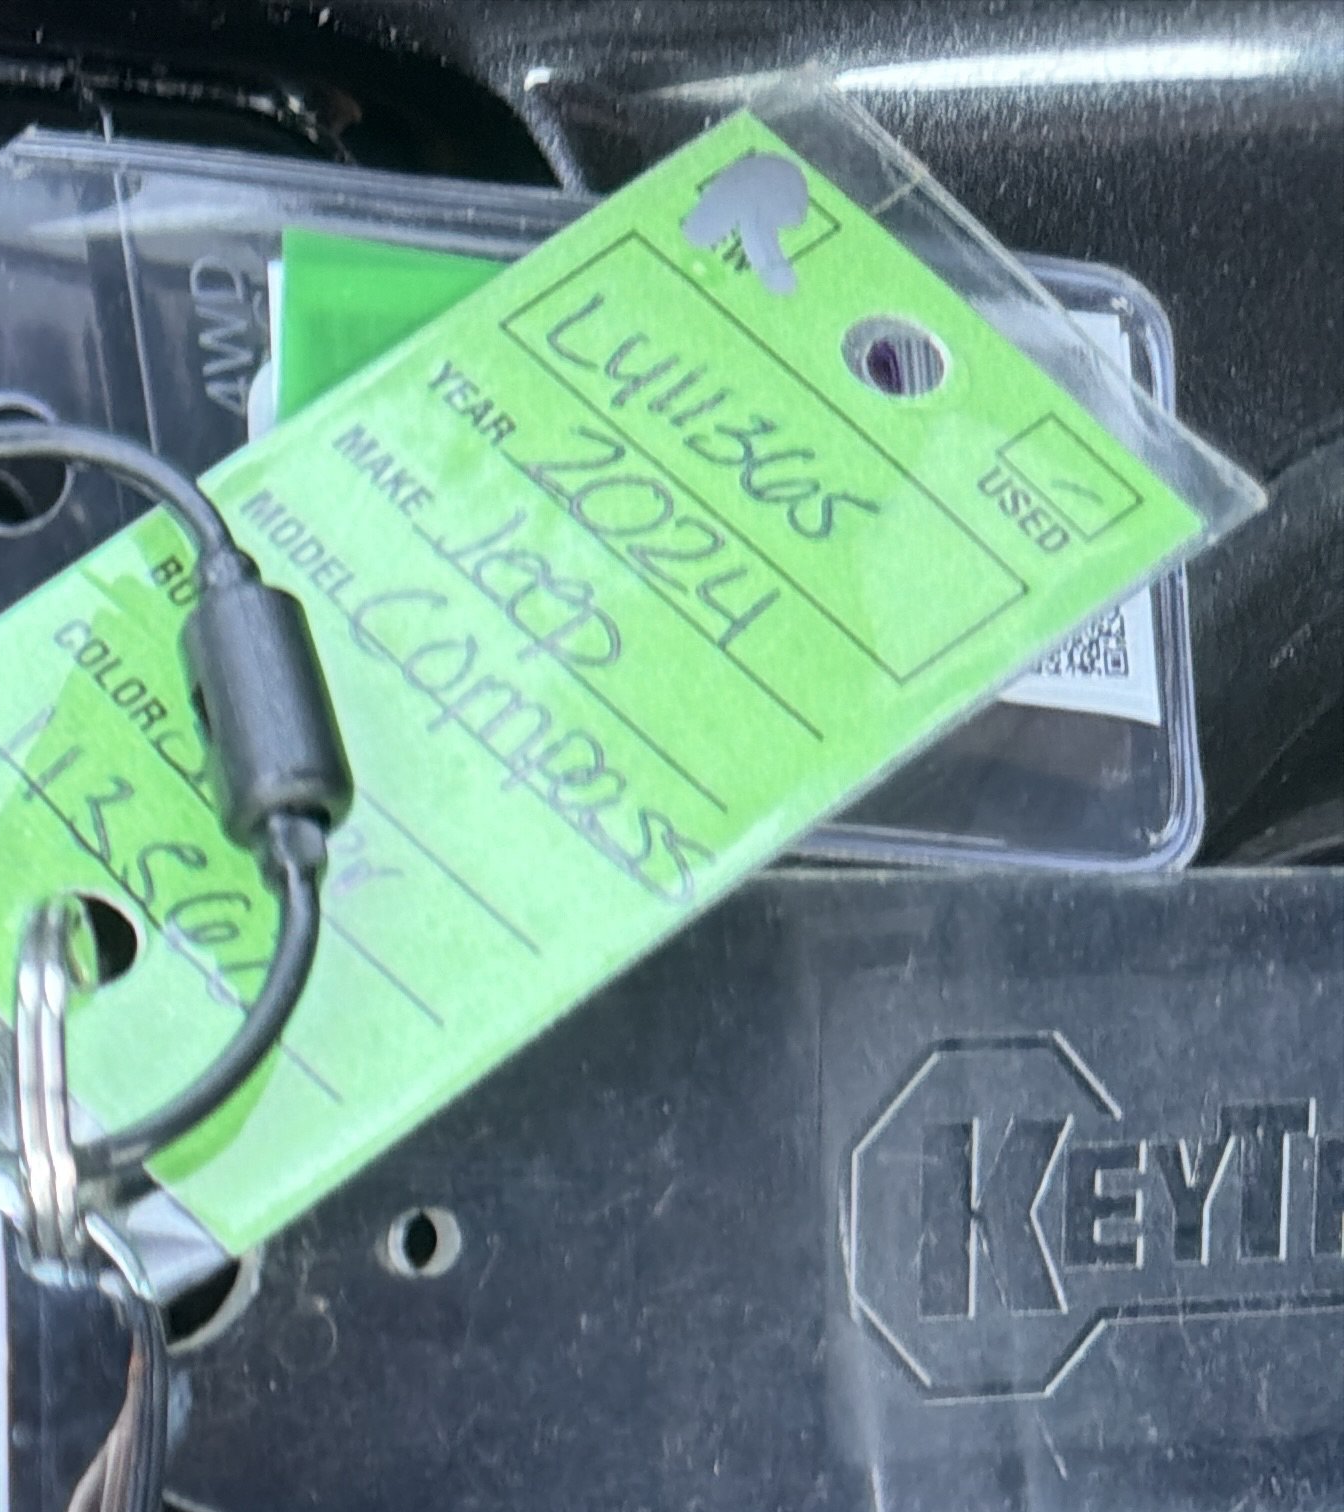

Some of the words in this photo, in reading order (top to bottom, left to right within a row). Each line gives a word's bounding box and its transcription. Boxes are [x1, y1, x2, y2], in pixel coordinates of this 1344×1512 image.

[426, 360, 517, 448] YEAR
[332, 423, 436, 514] MAKE
[976, 466, 1073, 556] USED
[240, 489, 359, 604] MODEL
[524, 423, 782, 650] 2024
[54, 618, 166, 733] COLOR
